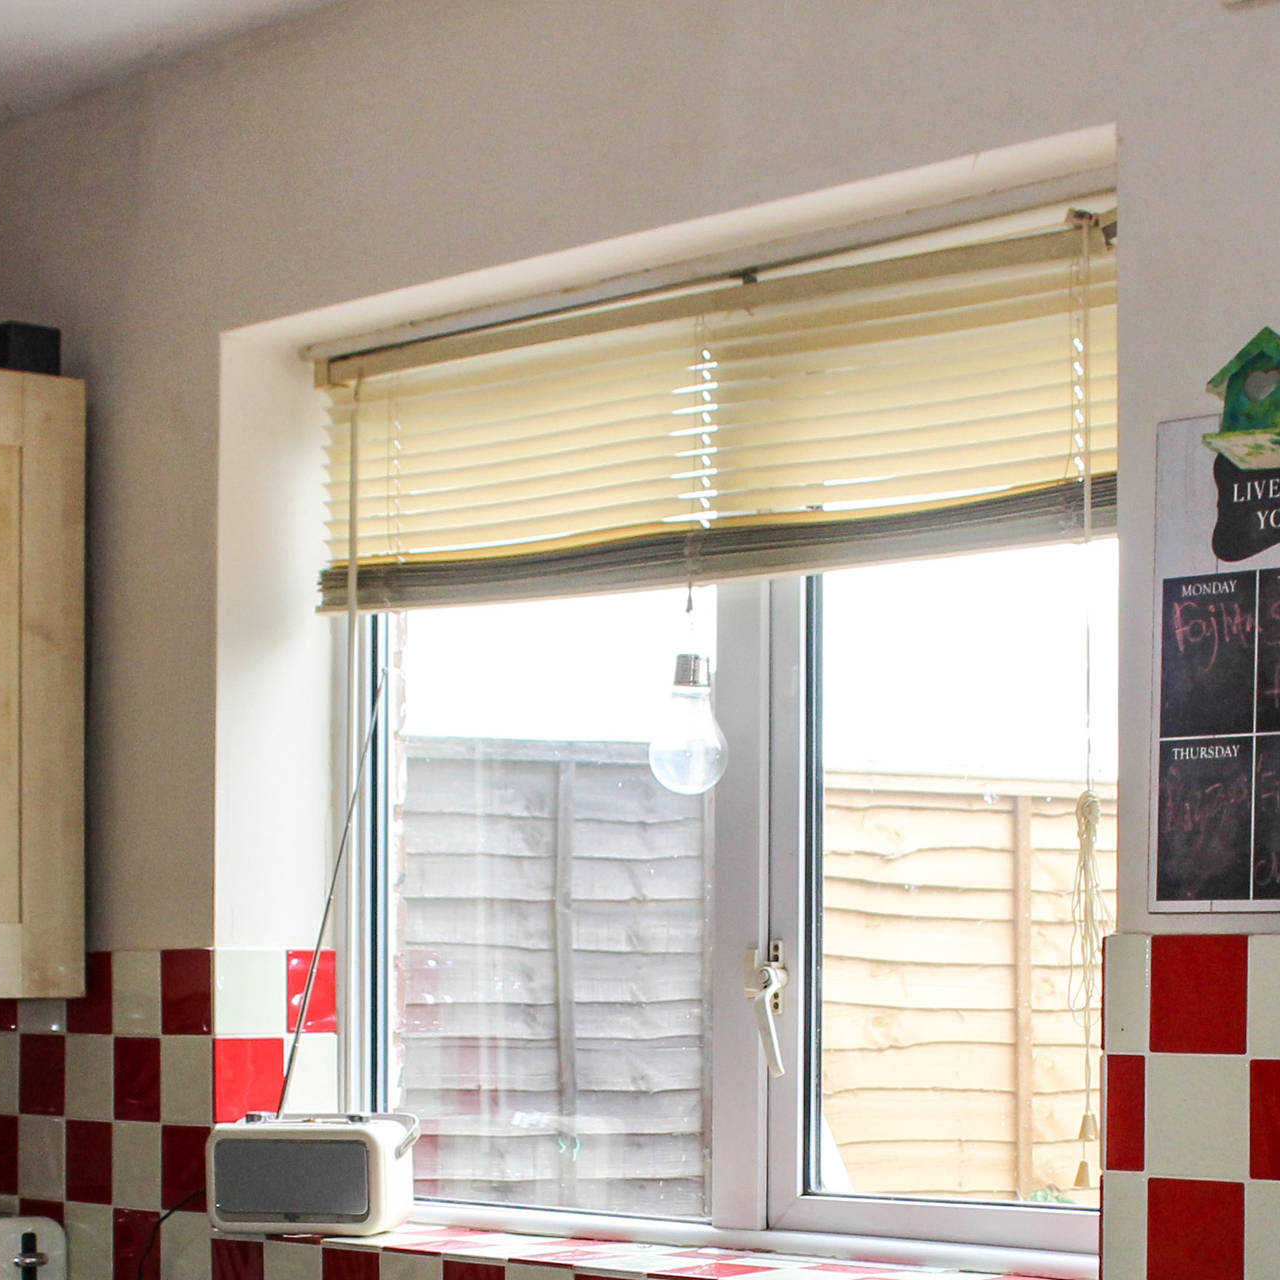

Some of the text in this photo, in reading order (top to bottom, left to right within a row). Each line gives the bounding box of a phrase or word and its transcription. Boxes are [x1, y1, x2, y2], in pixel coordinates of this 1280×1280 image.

[1233, 478, 1280, 503] LIVE
[1181, 580, 1237, 597] MONDAY
[1172, 745, 1240, 760] THURSDAY
